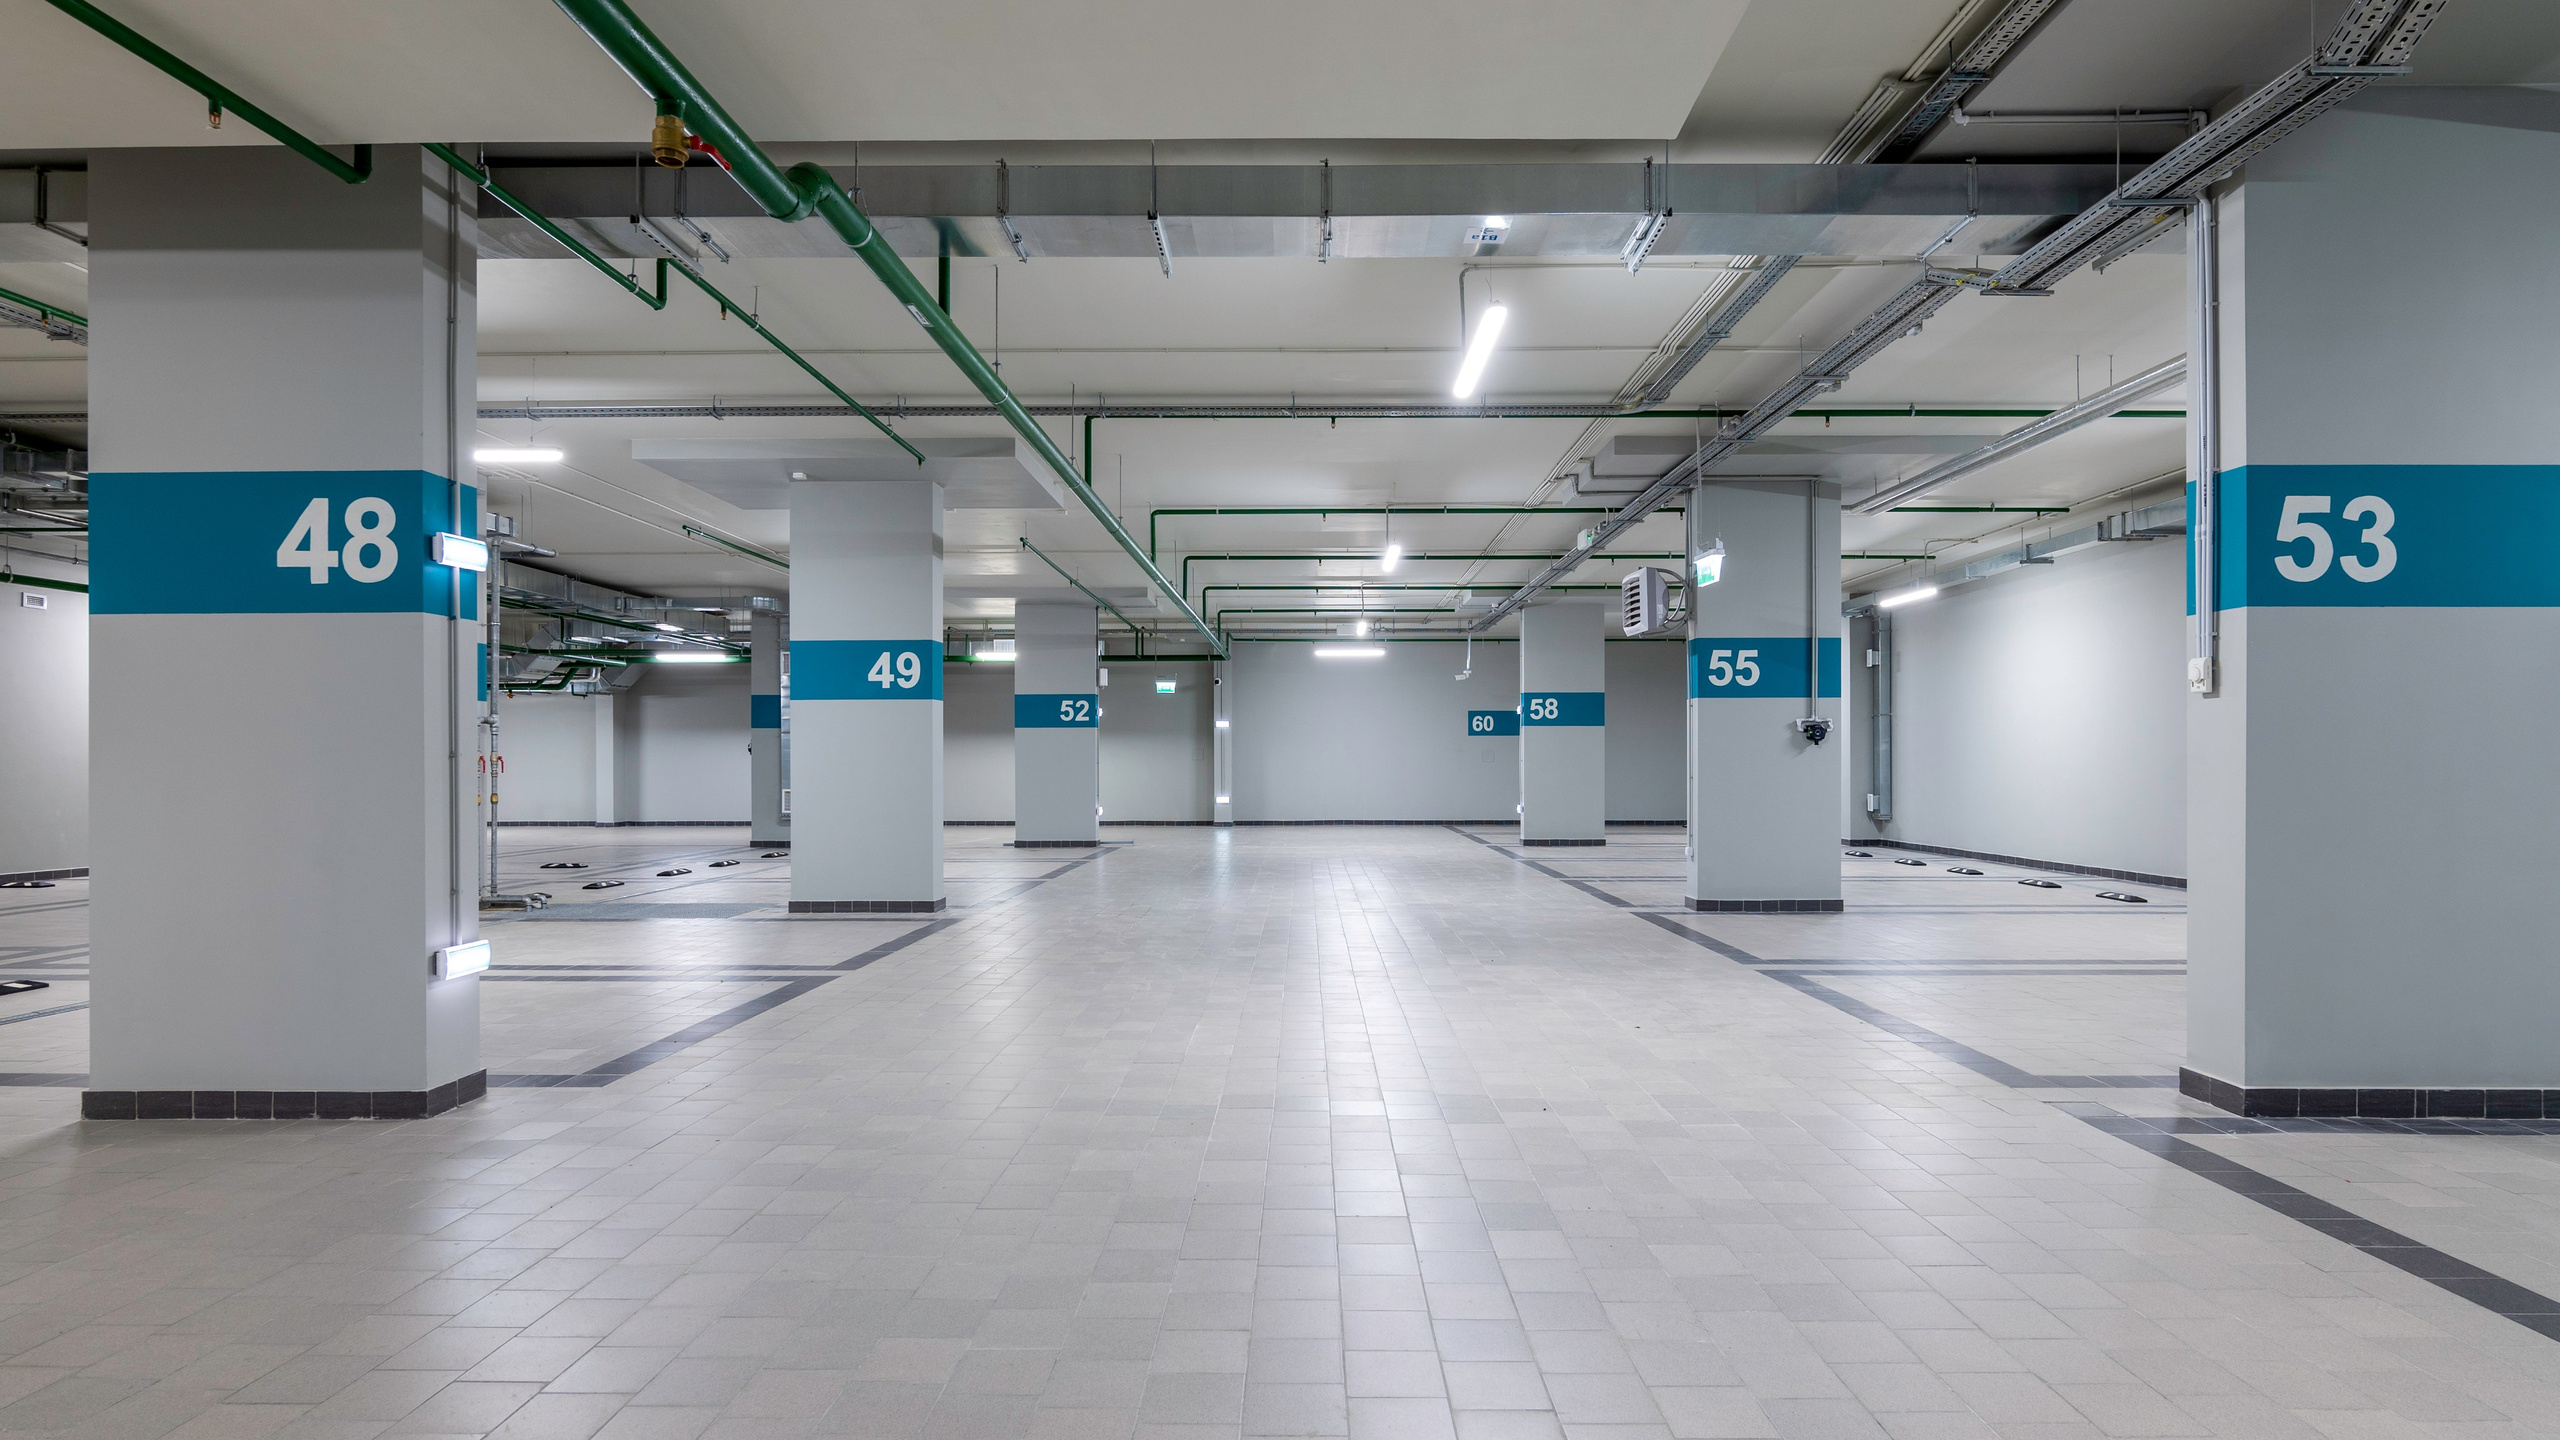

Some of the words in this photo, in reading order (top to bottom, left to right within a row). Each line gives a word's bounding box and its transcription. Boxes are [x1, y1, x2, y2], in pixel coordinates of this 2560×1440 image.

[276, 496, 399, 586] 48
[2274, 495, 2398, 583] 53
[867, 651, 921, 689] 49
[1708, 649, 1761, 687] 55
[1059, 699, 1091, 722] 52
[1472, 715, 1494, 733] 60
[1529, 697, 1559, 720] 58
